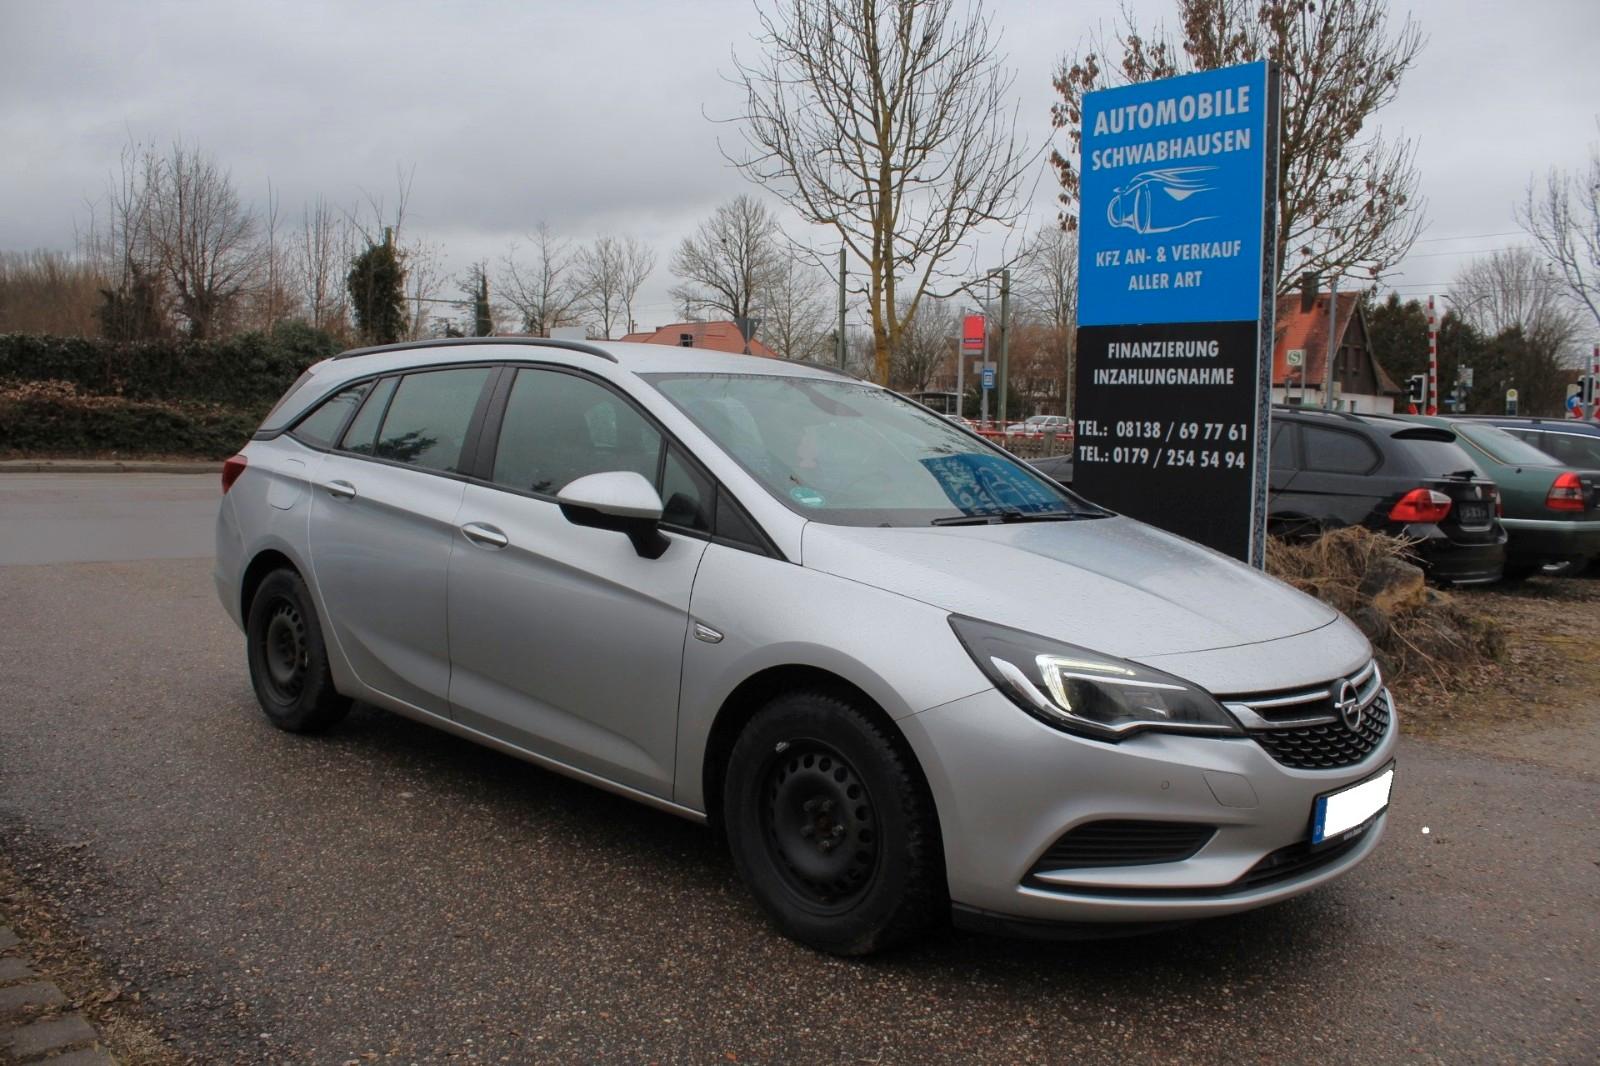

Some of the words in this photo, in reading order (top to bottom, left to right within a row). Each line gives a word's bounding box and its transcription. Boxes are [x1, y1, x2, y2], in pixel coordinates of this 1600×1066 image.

[1093, 86, 1250, 136] AUTOMOBILE
[1092, 128, 1251, 171] SCHWABHAUSEN
[1096, 250, 1120, 267] KFZ
[1125, 248, 1151, 264] AN-
[1156, 246, 1167, 263] &
[1171, 240, 1242, 261] VERKAUF
[1128, 273, 1169, 291] ALLER
[1174, 270, 1202, 288] ART
[1108, 340, 1219, 359] FINANZIERUNG
[1093, 368, 1234, 385] INZAHLUNGNAHME
[1078, 420, 1108, 437] TEL.:
[1116, 421, 1161, 439] 08138
[1165, 421, 1175, 443] /
[1179, 422, 1198, 440] 69
[1204, 423, 1224, 440] 77
[1228, 424, 1247, 441] 61
[1080, 446, 1109, 462] TEL.:
[1113, 447, 1149, 464] 0179
[1152, 448, 1162, 469] /
[1167, 449, 1195, 468] 254
[1200, 451, 1219, 468] 54
[1225, 451, 1245, 469] 94
